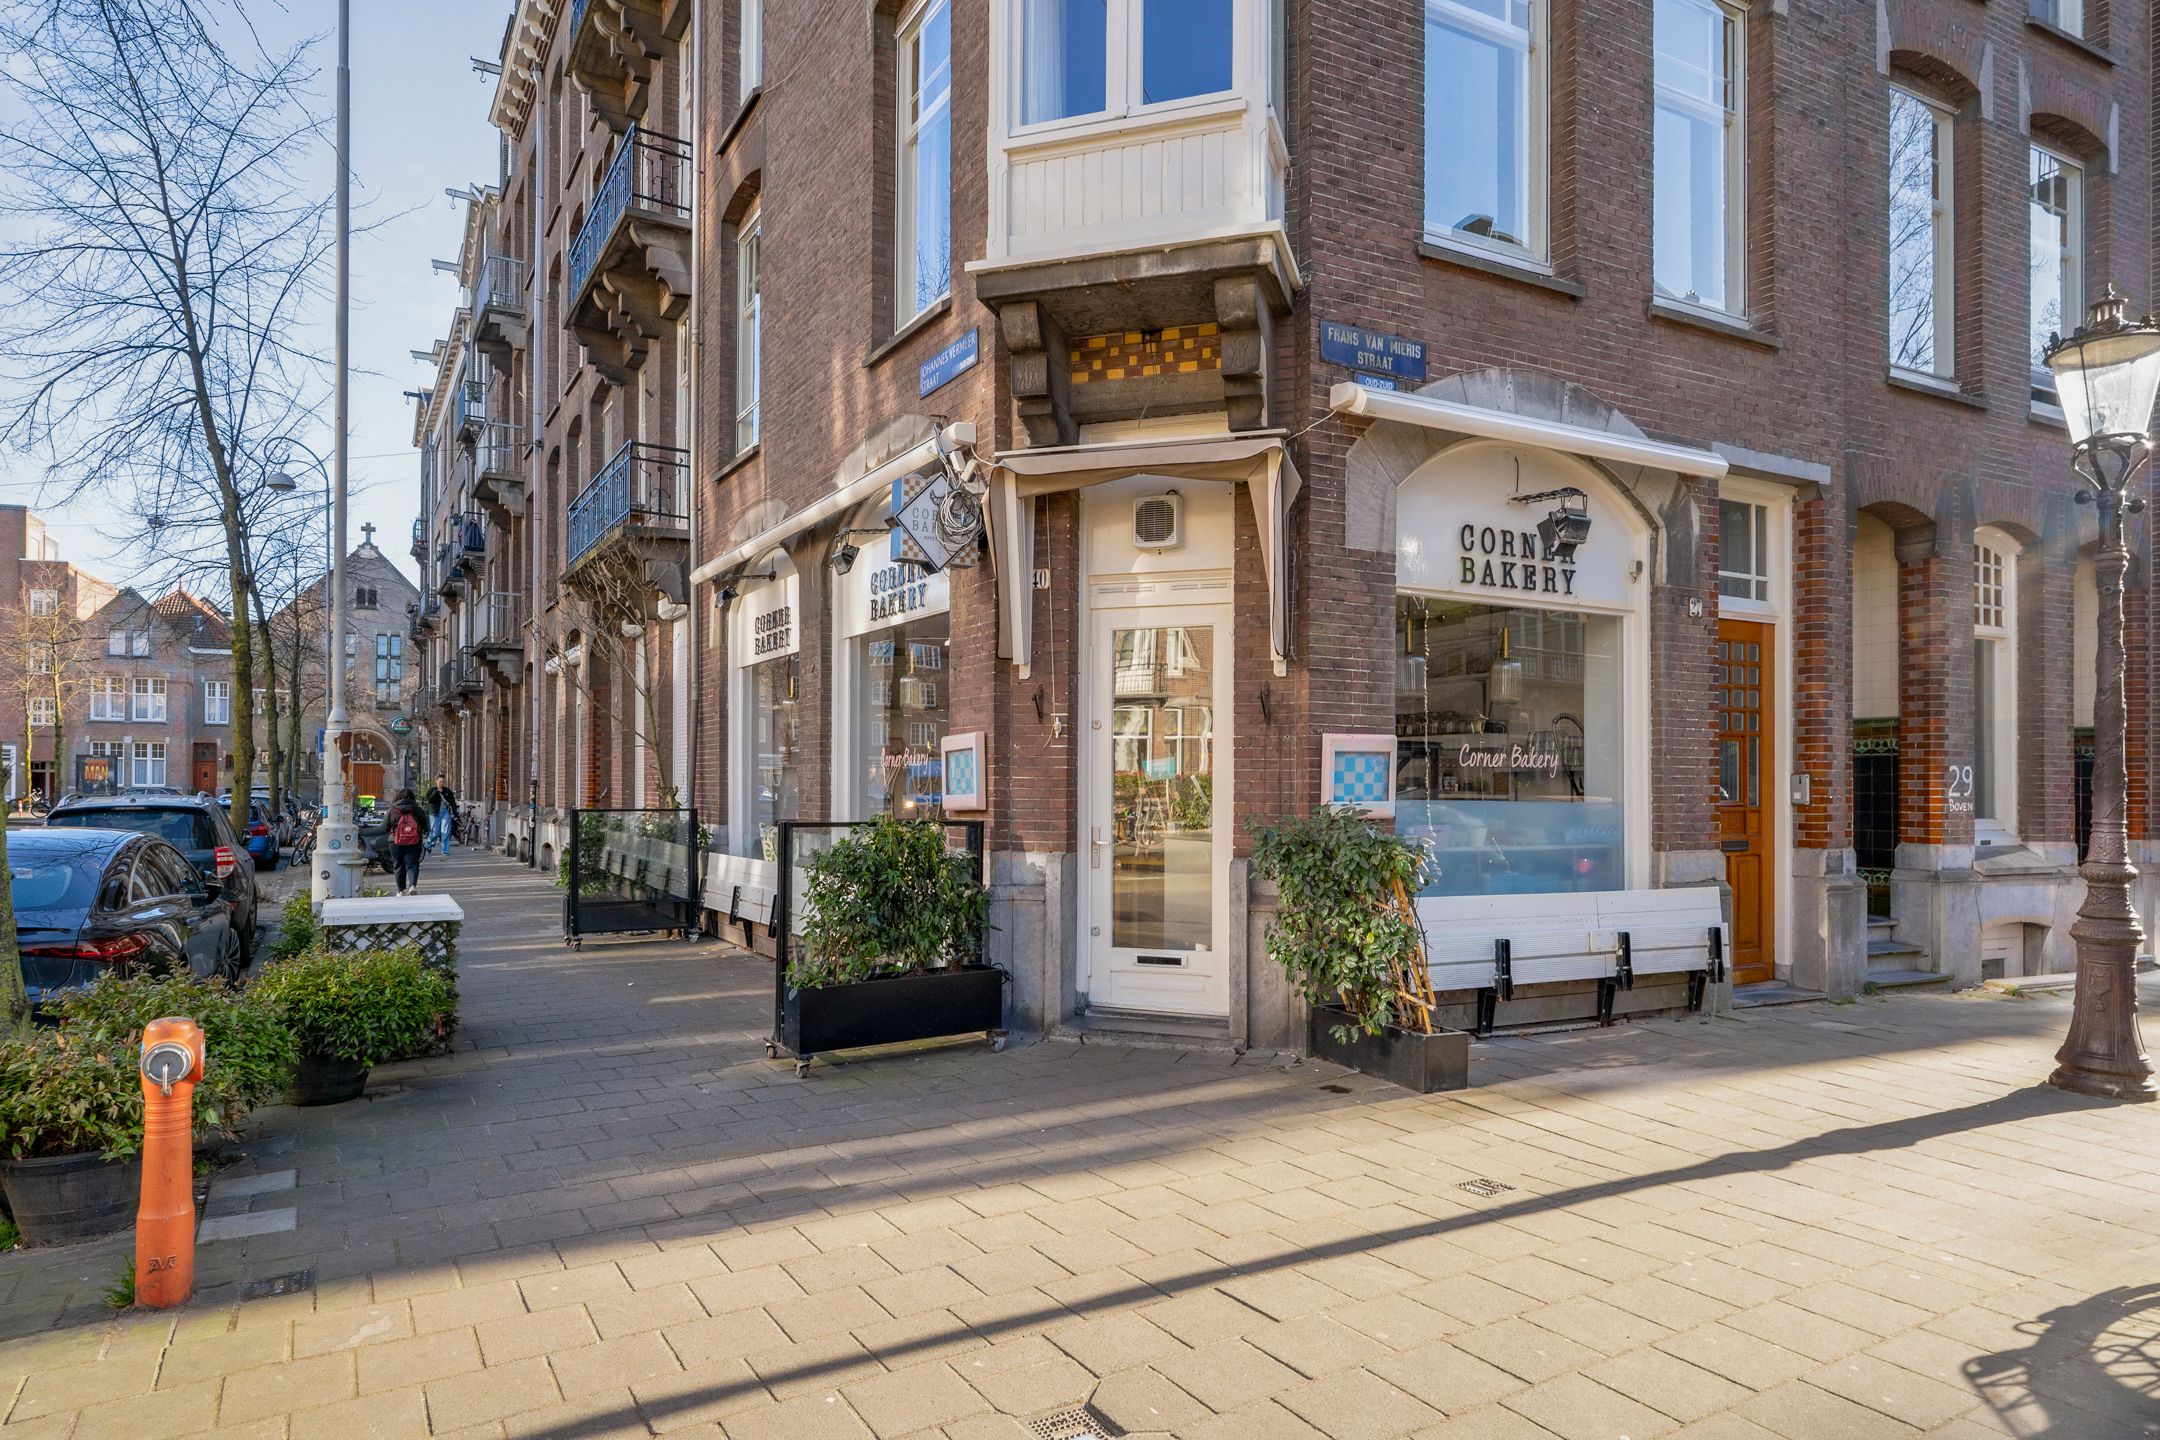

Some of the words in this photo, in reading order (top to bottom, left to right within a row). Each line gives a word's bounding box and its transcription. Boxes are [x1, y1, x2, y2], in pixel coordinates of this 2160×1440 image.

[949, 332, 976, 359] VERMEER
[1328, 327, 1359, 346] FRANS
[1365, 334, 1384, 352] VAN
[1390, 341, 1421, 359] MIERIS
[1357, 351, 1394, 370] STRAAT
[920, 371, 940, 394] STRAAT
[1365, 377, 1393, 391] OUD-ZUID
[1460, 556, 1577, 595] BAKERY
[870, 582, 927, 622] BAKERY
[755, 606, 792, 635] CORNER
[755, 627, 792, 656] BAKERY
[1459, 743, 1507, 768] Corner
[1511, 744, 1559, 778] Bakery
[1949, 765, 1973, 797] 29
